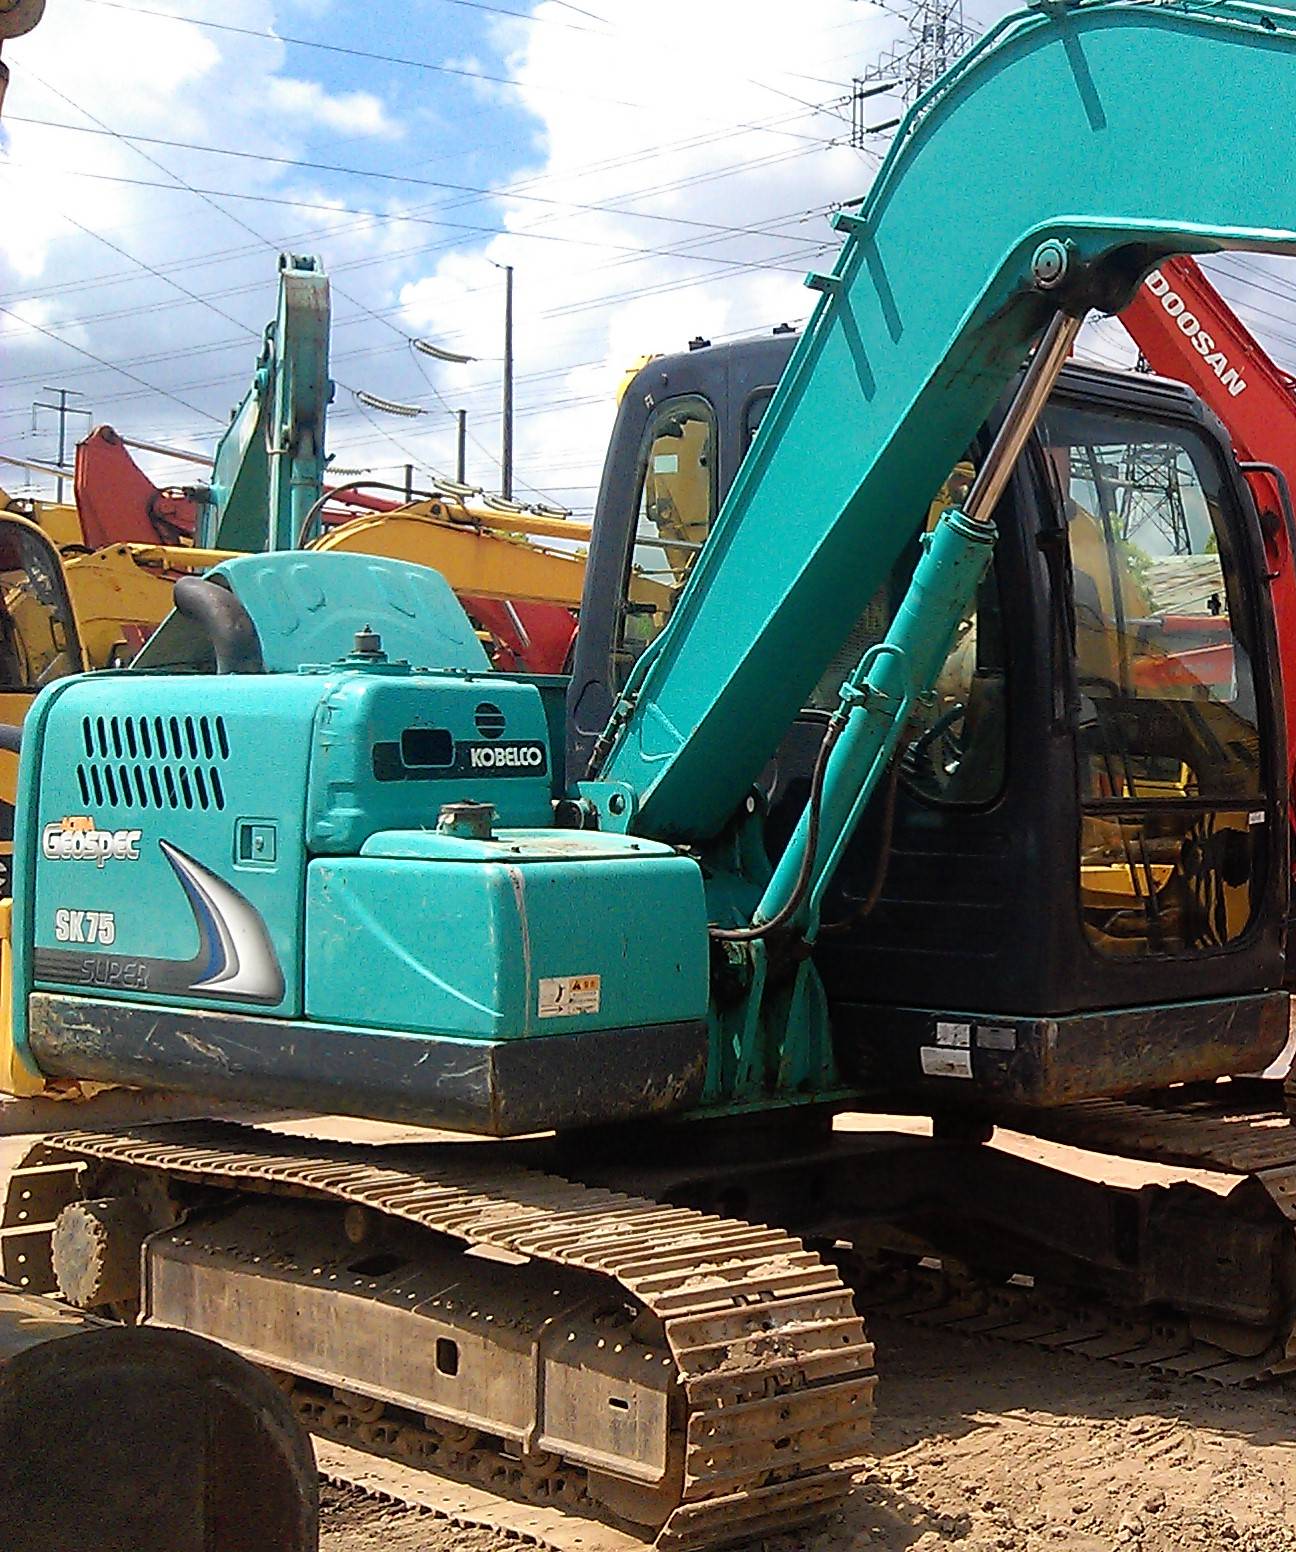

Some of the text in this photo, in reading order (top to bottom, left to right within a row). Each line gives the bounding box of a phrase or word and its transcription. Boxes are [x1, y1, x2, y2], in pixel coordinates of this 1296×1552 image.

[1144, 269, 1247, 397] DOOSAN
[470, 746, 542, 767] KOBELCO
[54, 909, 116, 945] SK75
[80, 959, 149, 990] SUPER
